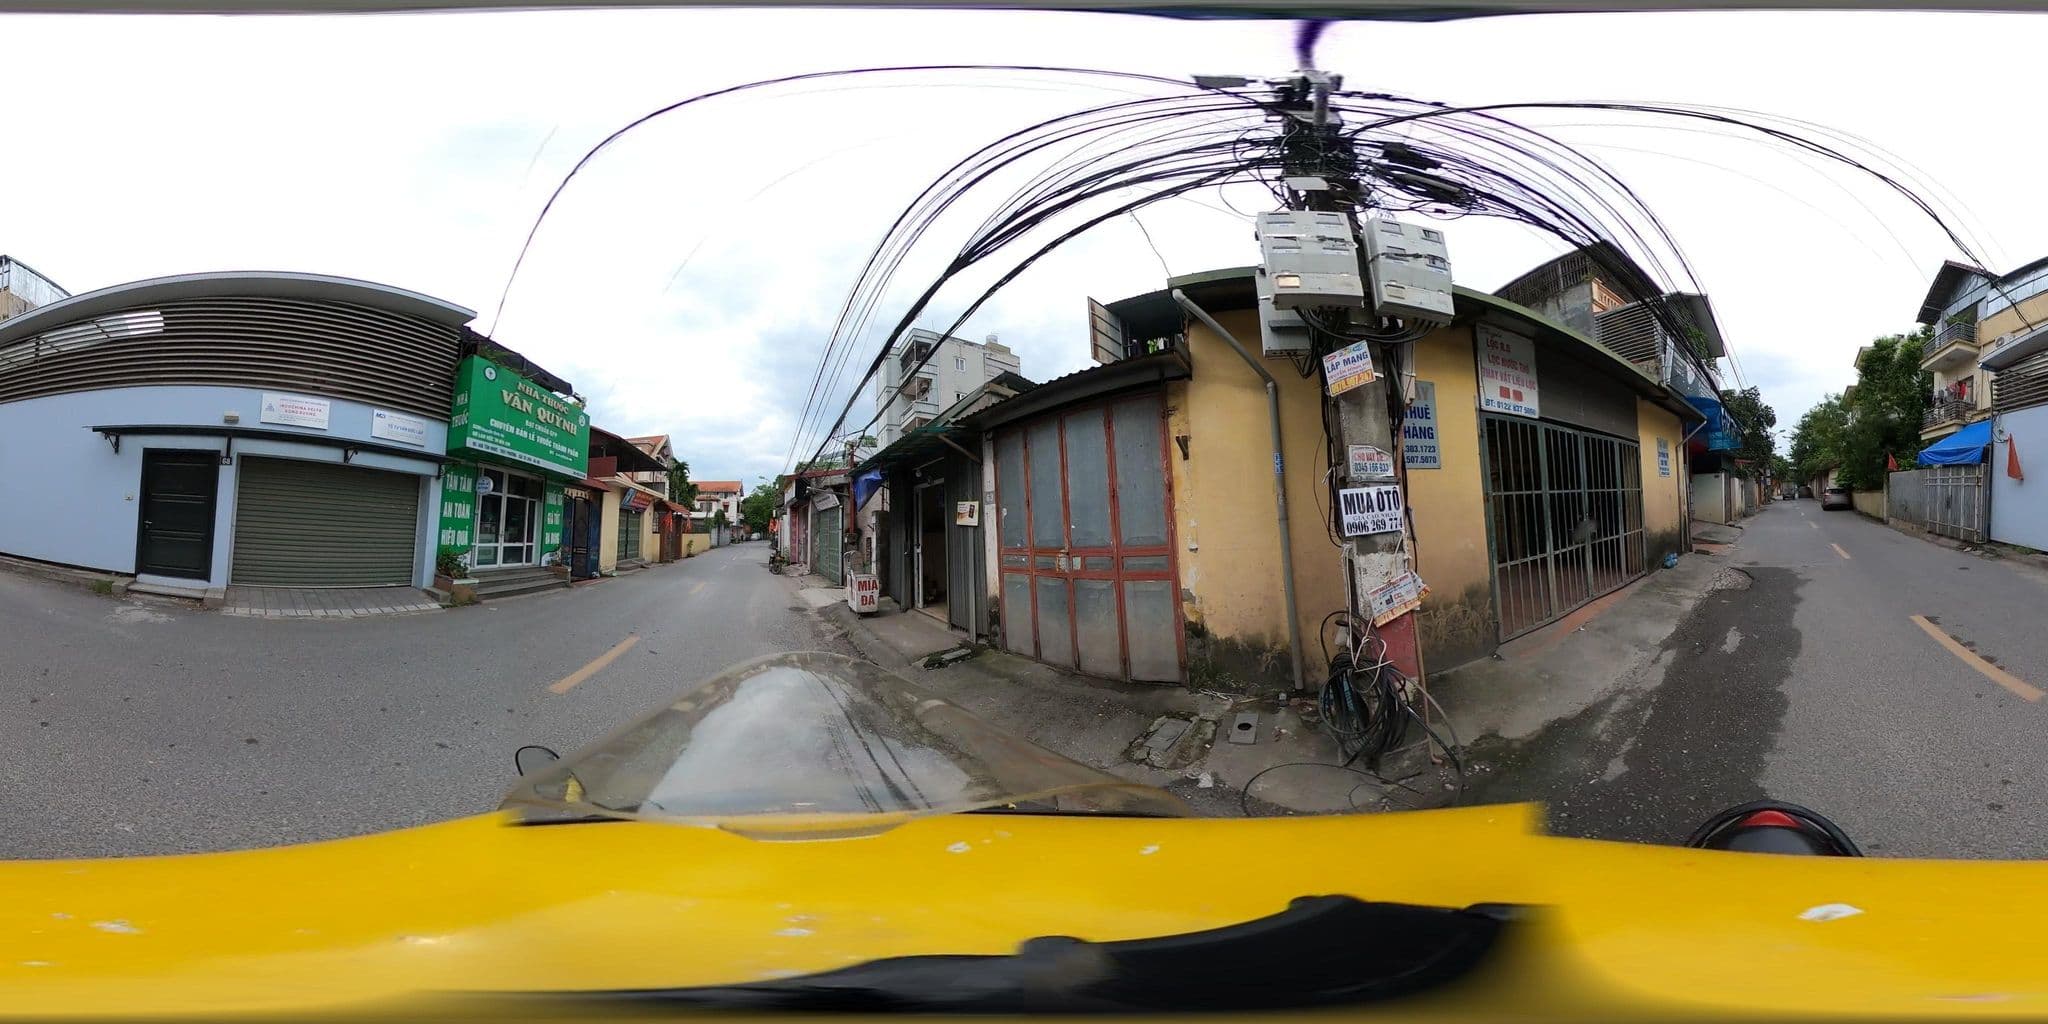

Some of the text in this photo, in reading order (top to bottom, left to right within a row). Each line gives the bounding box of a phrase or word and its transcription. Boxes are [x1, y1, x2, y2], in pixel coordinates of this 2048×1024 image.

[517, 381, 540, 400] NHÀ
[502, 389, 577, 436] VÂN QUỲNH
[1403, 422, 1434, 440] HÀNG
[442, 501, 471, 519] AN TOÀN
[1343, 486, 1400, 516] MUA ÔTÔ
[1346, 517, 1403, 534] 0906 269 774
